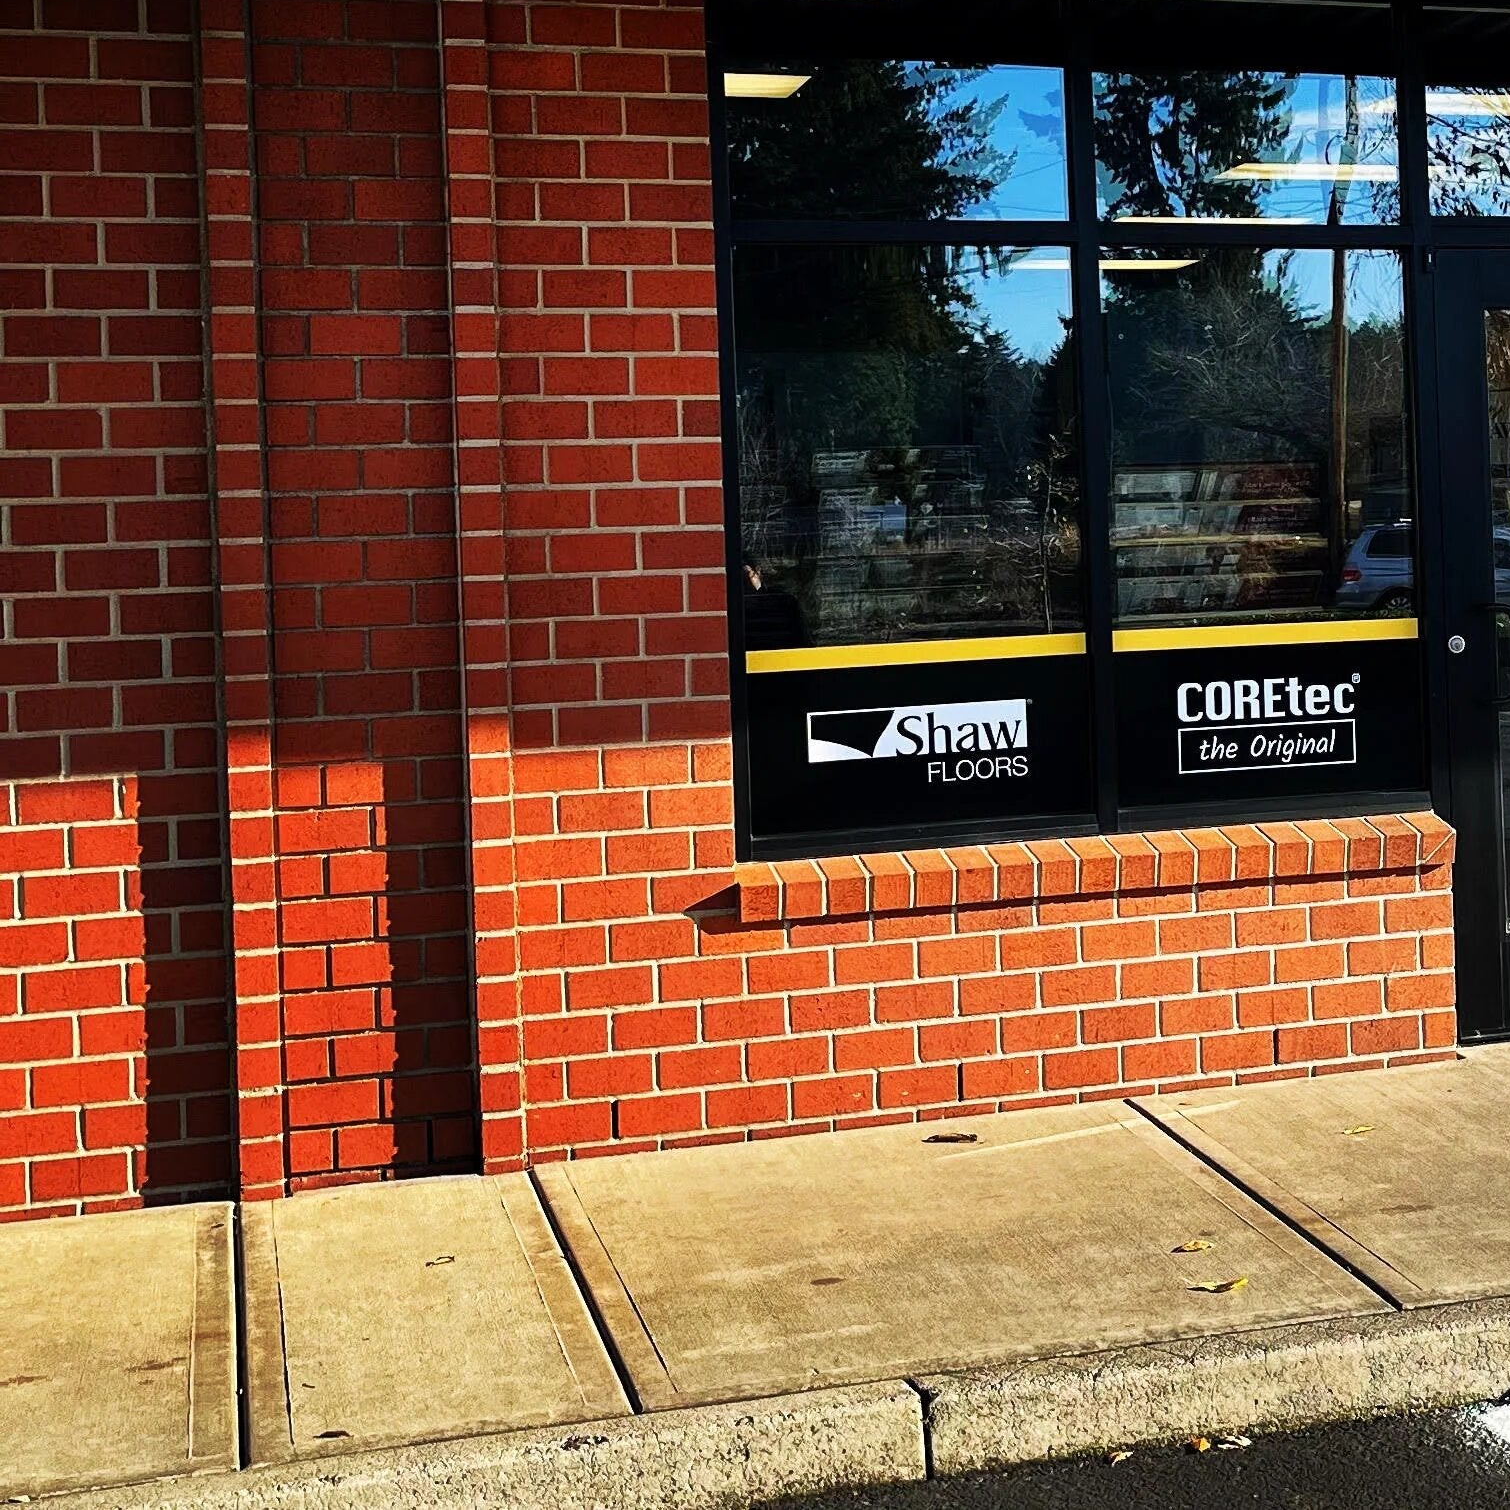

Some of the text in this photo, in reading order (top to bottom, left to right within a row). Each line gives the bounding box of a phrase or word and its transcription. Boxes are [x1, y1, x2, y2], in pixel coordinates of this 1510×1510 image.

[1177, 676, 1356, 723] COREtec
[895, 711, 1023, 758] Shaw
[1199, 728, 1336, 764] the Original
[927, 755, 1029, 783] FLOORS
